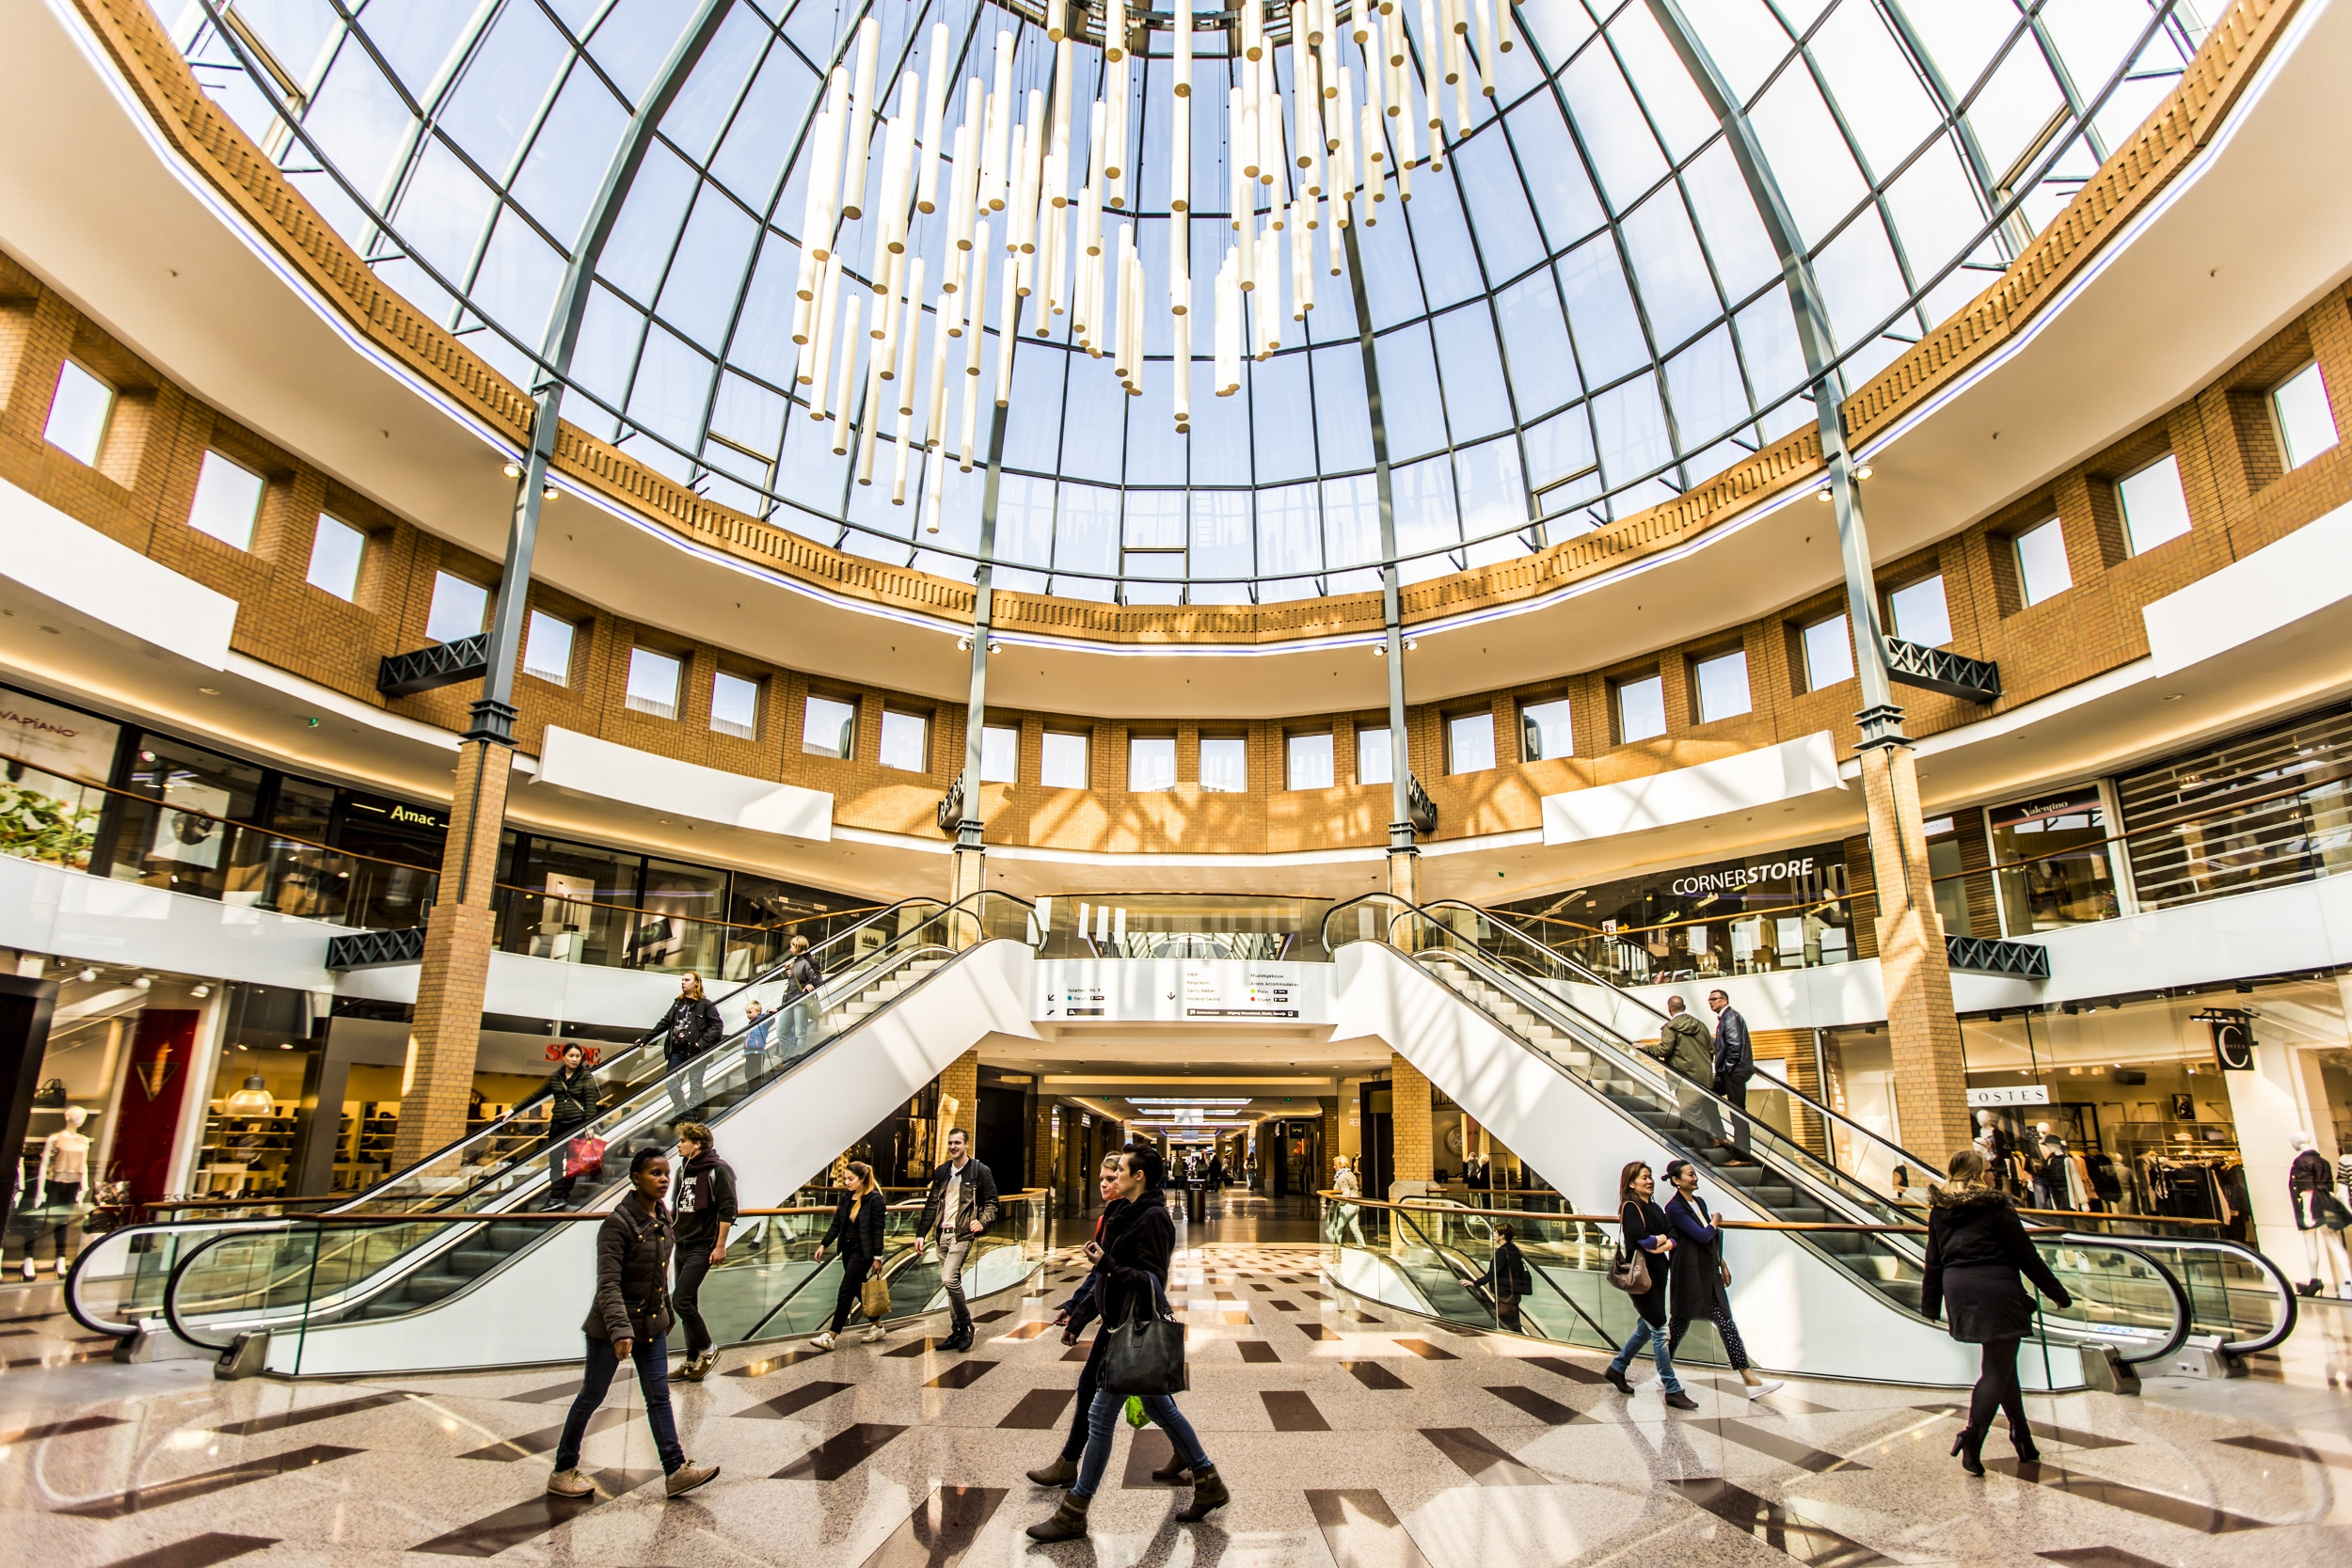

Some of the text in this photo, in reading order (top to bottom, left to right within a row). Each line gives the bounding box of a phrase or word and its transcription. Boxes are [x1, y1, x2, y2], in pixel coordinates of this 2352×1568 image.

[389, 805, 436, 826] Amac
[2021, 801, 2069, 817] Valentino
[1673, 857, 1814, 895] CORNERSTORE
